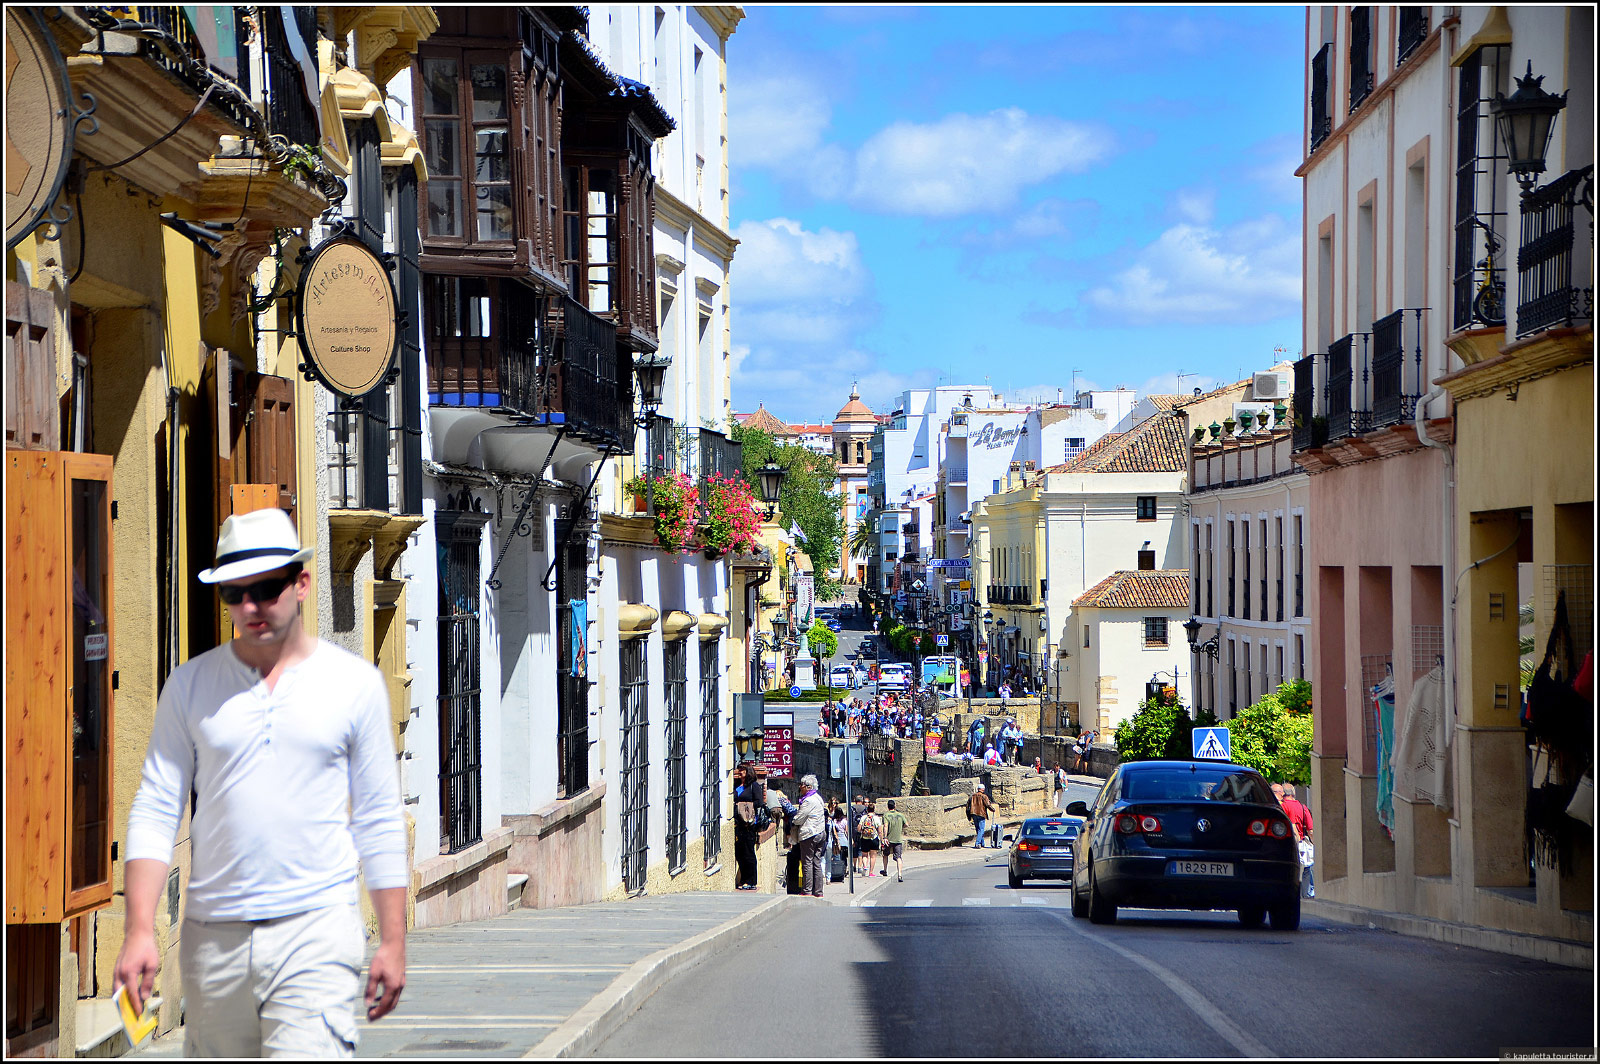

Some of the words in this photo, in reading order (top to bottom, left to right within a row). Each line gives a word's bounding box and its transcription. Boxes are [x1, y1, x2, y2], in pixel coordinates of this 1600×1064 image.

[355, 326, 378, 334] Regalos
[330, 345, 354, 353] Culture
[355, 345, 371, 354] Shop
[992, 423, 1020, 442] Bomb
[1180, 862, 1207, 874] 1829
[1210, 863, 1229, 875] FRY
